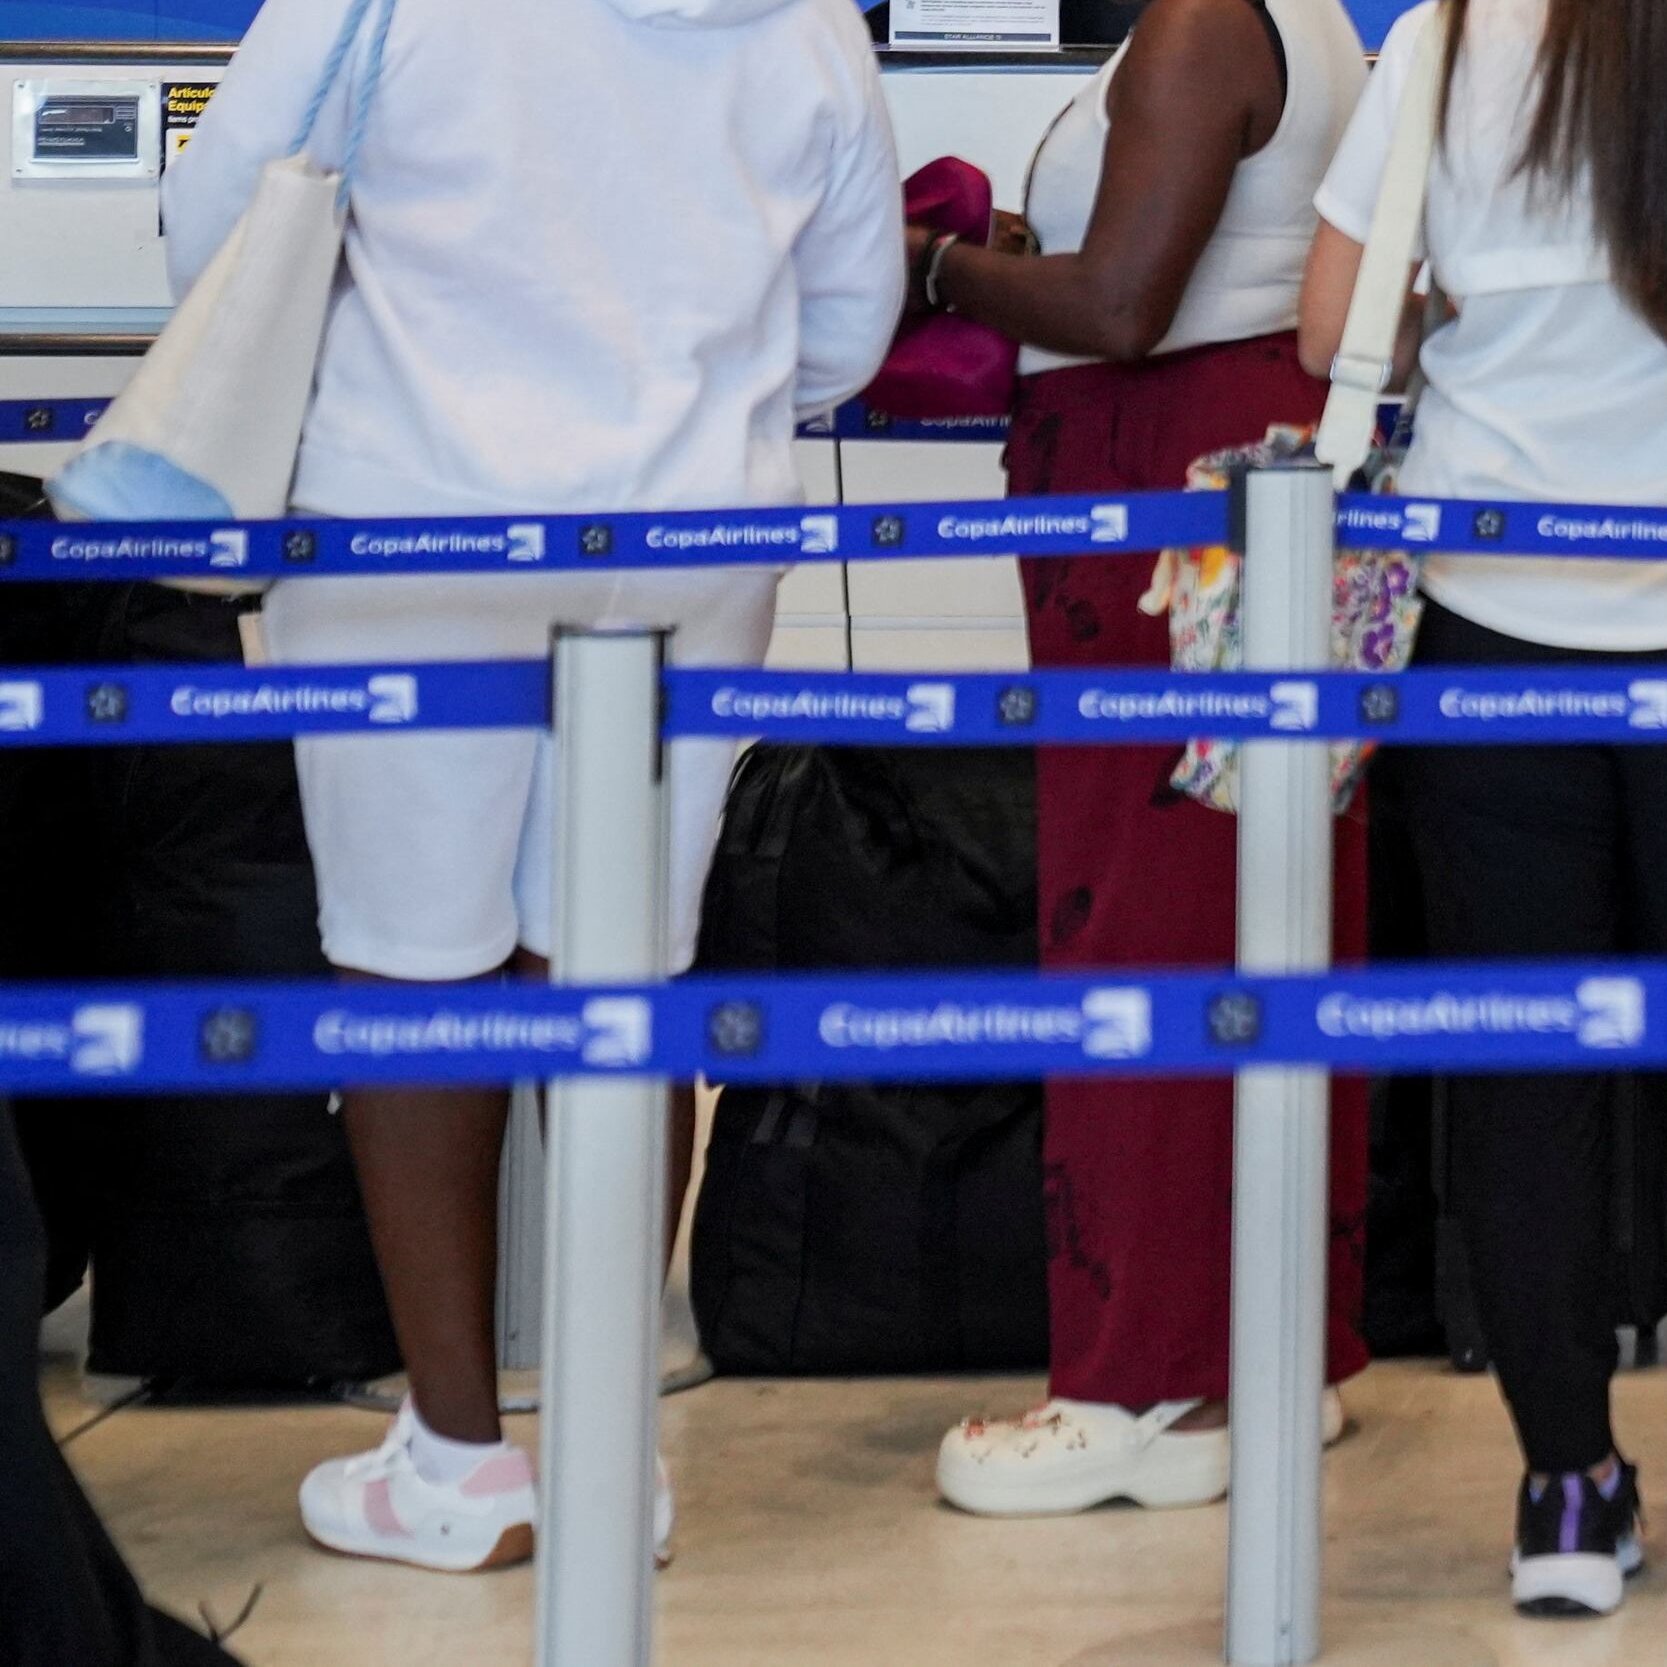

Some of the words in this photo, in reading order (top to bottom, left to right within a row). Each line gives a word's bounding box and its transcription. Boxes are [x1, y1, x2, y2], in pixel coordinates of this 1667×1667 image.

[51, 537, 206, 563] CopaAirlines
[350, 533, 504, 558] CopaAirlines
[646, 526, 797, 551] CopaAirlines
[937, 515, 1090, 541] CopaAirlines
[170, 686, 367, 718] CopaAirlines
[711, 689, 906, 722] CopaAirlines
[1079, 689, 1268, 722] CopaAirlines
[1439, 688, 1628, 720] CopaAirlines
